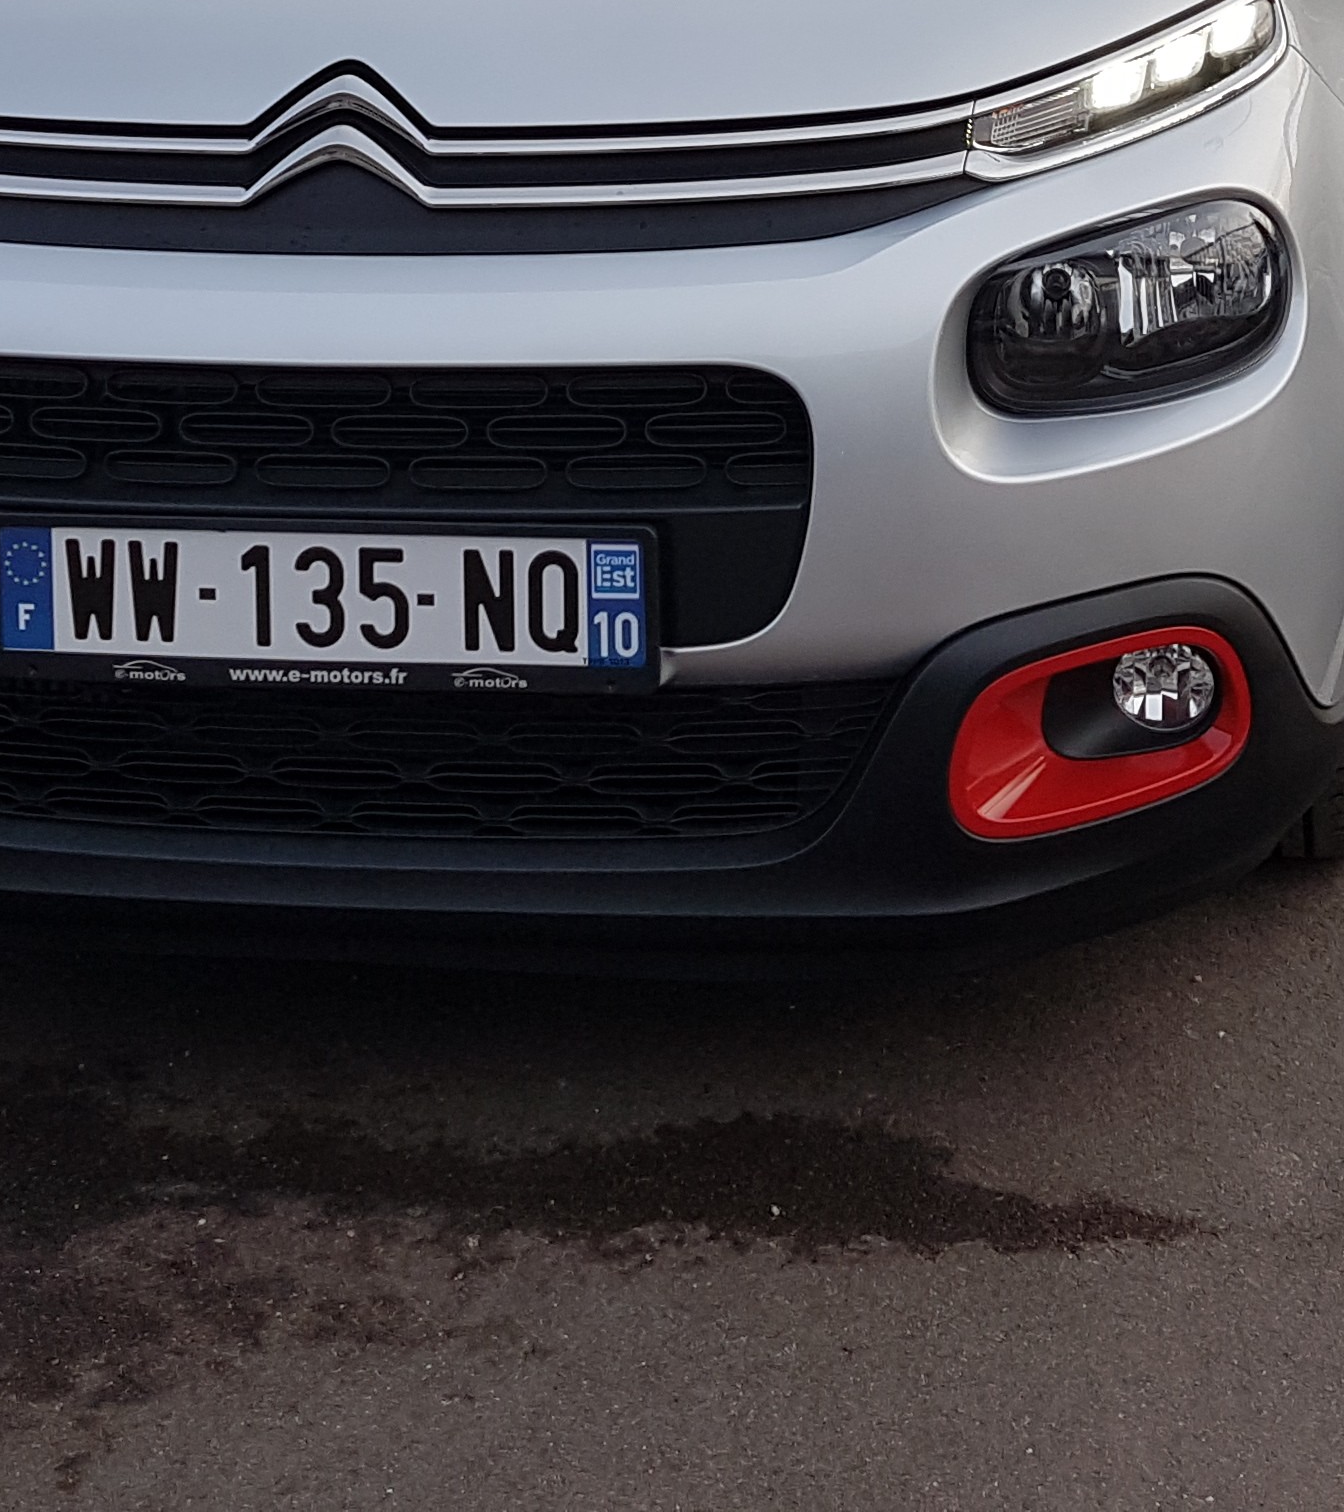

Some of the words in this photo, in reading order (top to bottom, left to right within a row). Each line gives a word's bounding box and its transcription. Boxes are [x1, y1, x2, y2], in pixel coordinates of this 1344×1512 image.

[596, 553, 635, 566] Grand
[596, 566, 636, 588] Est
[17, 603, 36, 631] F
[64, 538, 580, 654] WW-135-NQ
[593, 611, 640, 658] 10
[228, 667, 408, 685] www.e-motors.fr
